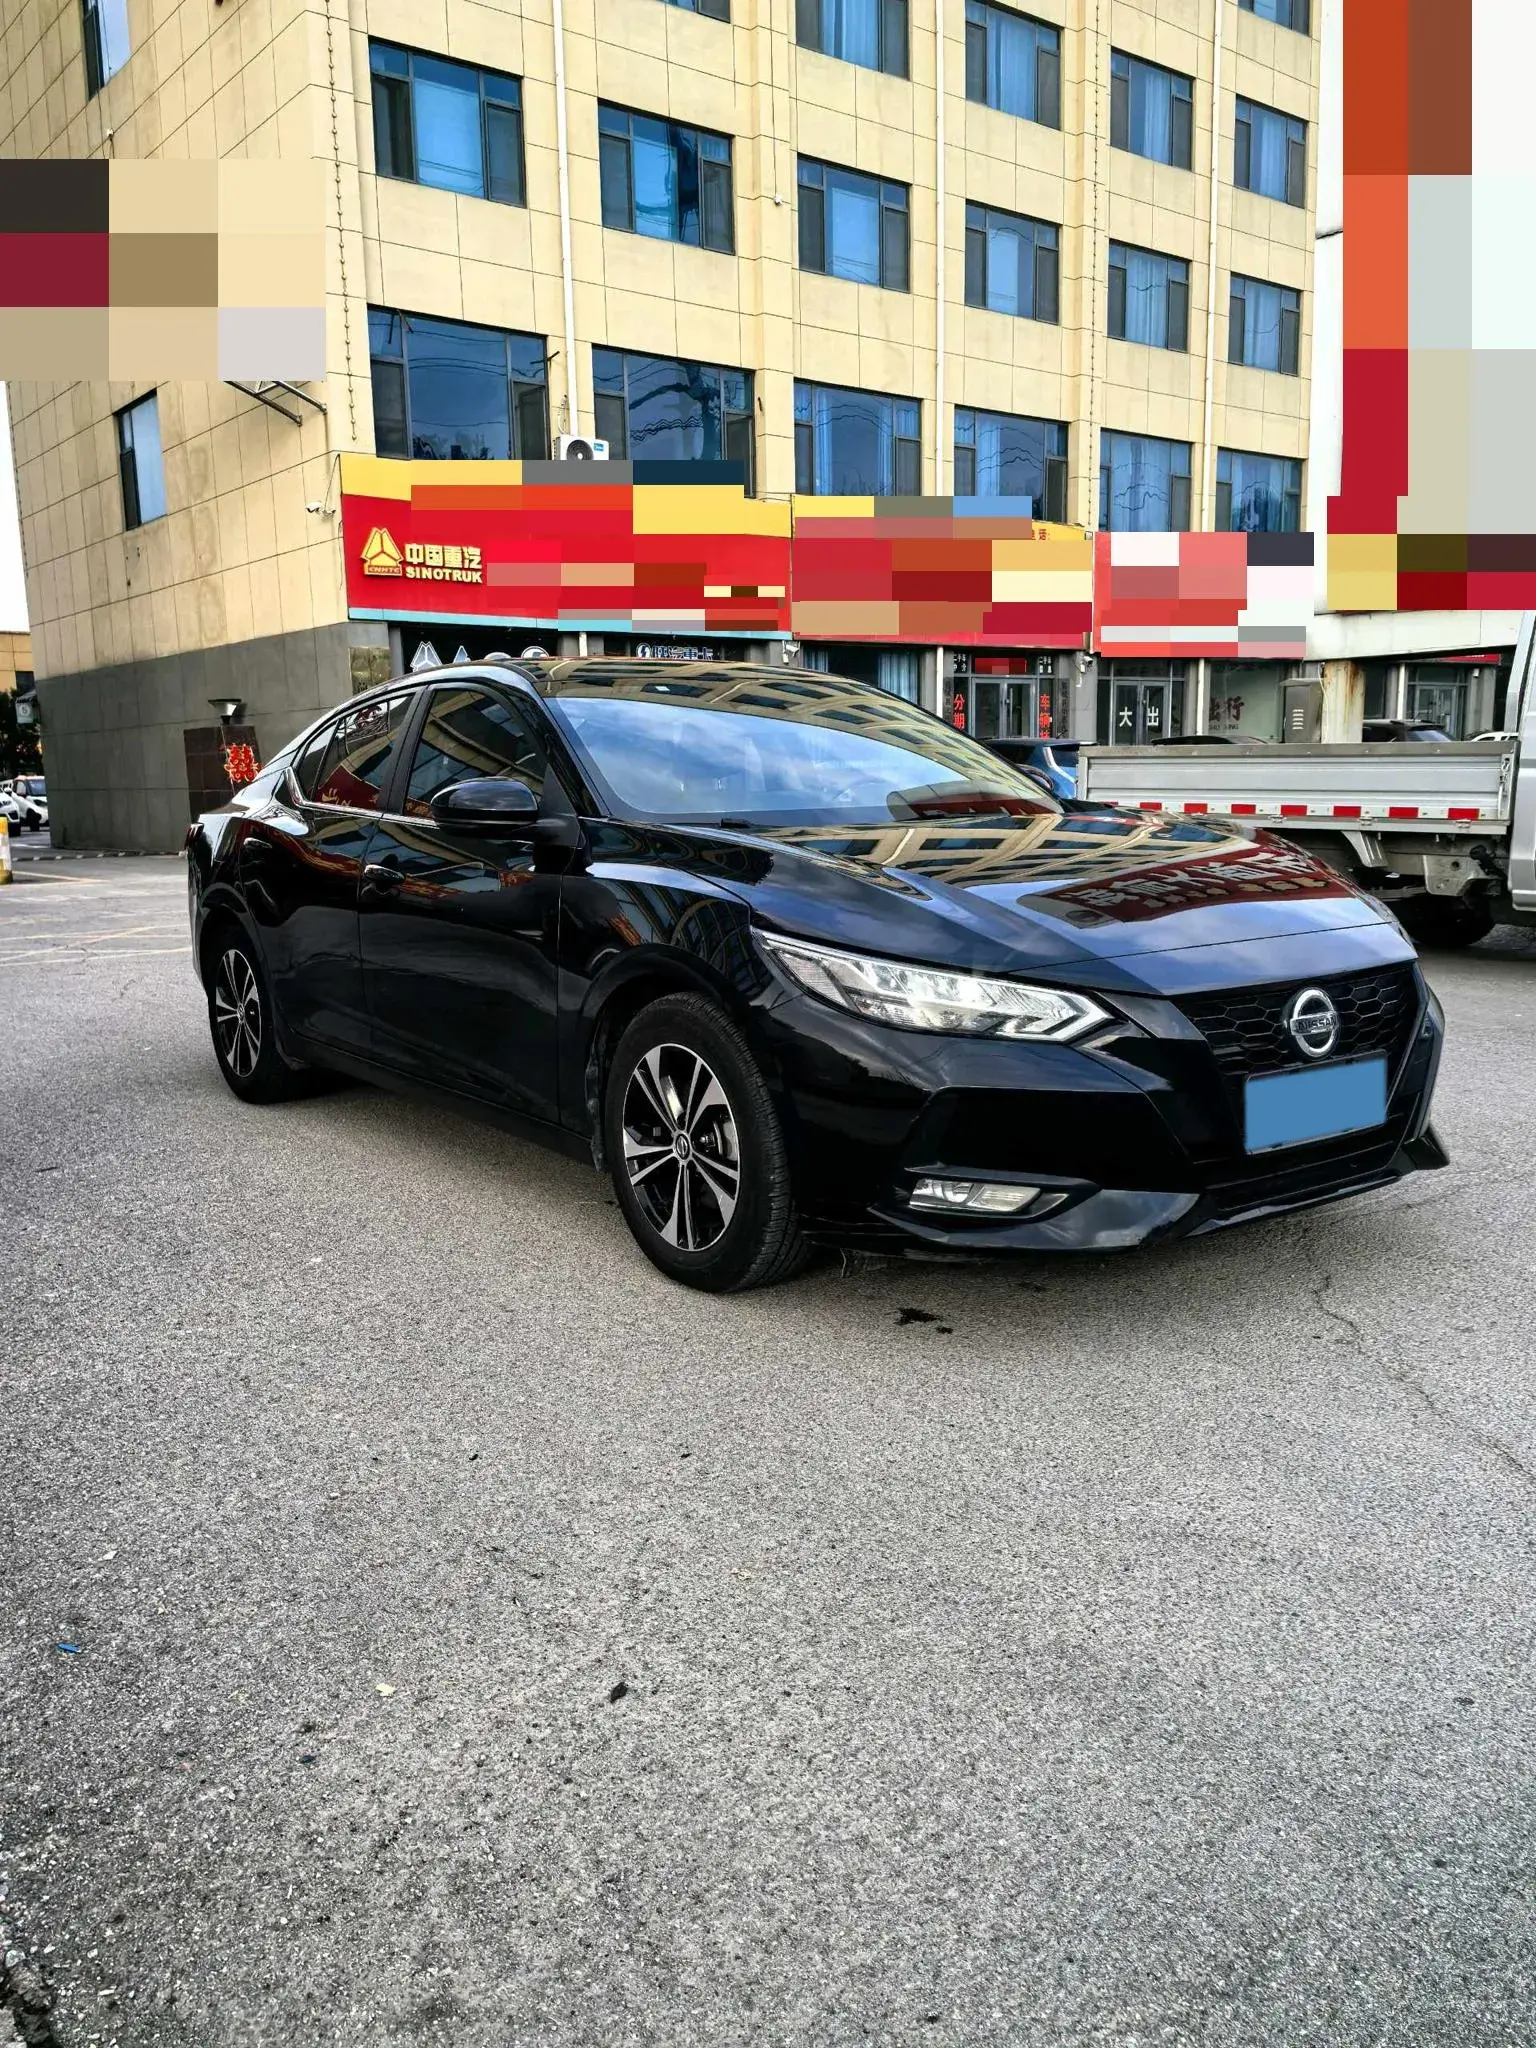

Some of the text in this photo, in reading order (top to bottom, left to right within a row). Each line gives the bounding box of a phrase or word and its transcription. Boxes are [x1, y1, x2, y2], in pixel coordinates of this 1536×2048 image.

[405, 543, 483, 569] 中国重汽
[368, 565, 400, 574] CNHTC
[405, 566, 483, 584] SINOTRUK
[953, 694, 966, 729] 分期
[1119, 705, 1159, 727] 大 出
[1297, 1013, 1336, 1029] NISSAN
